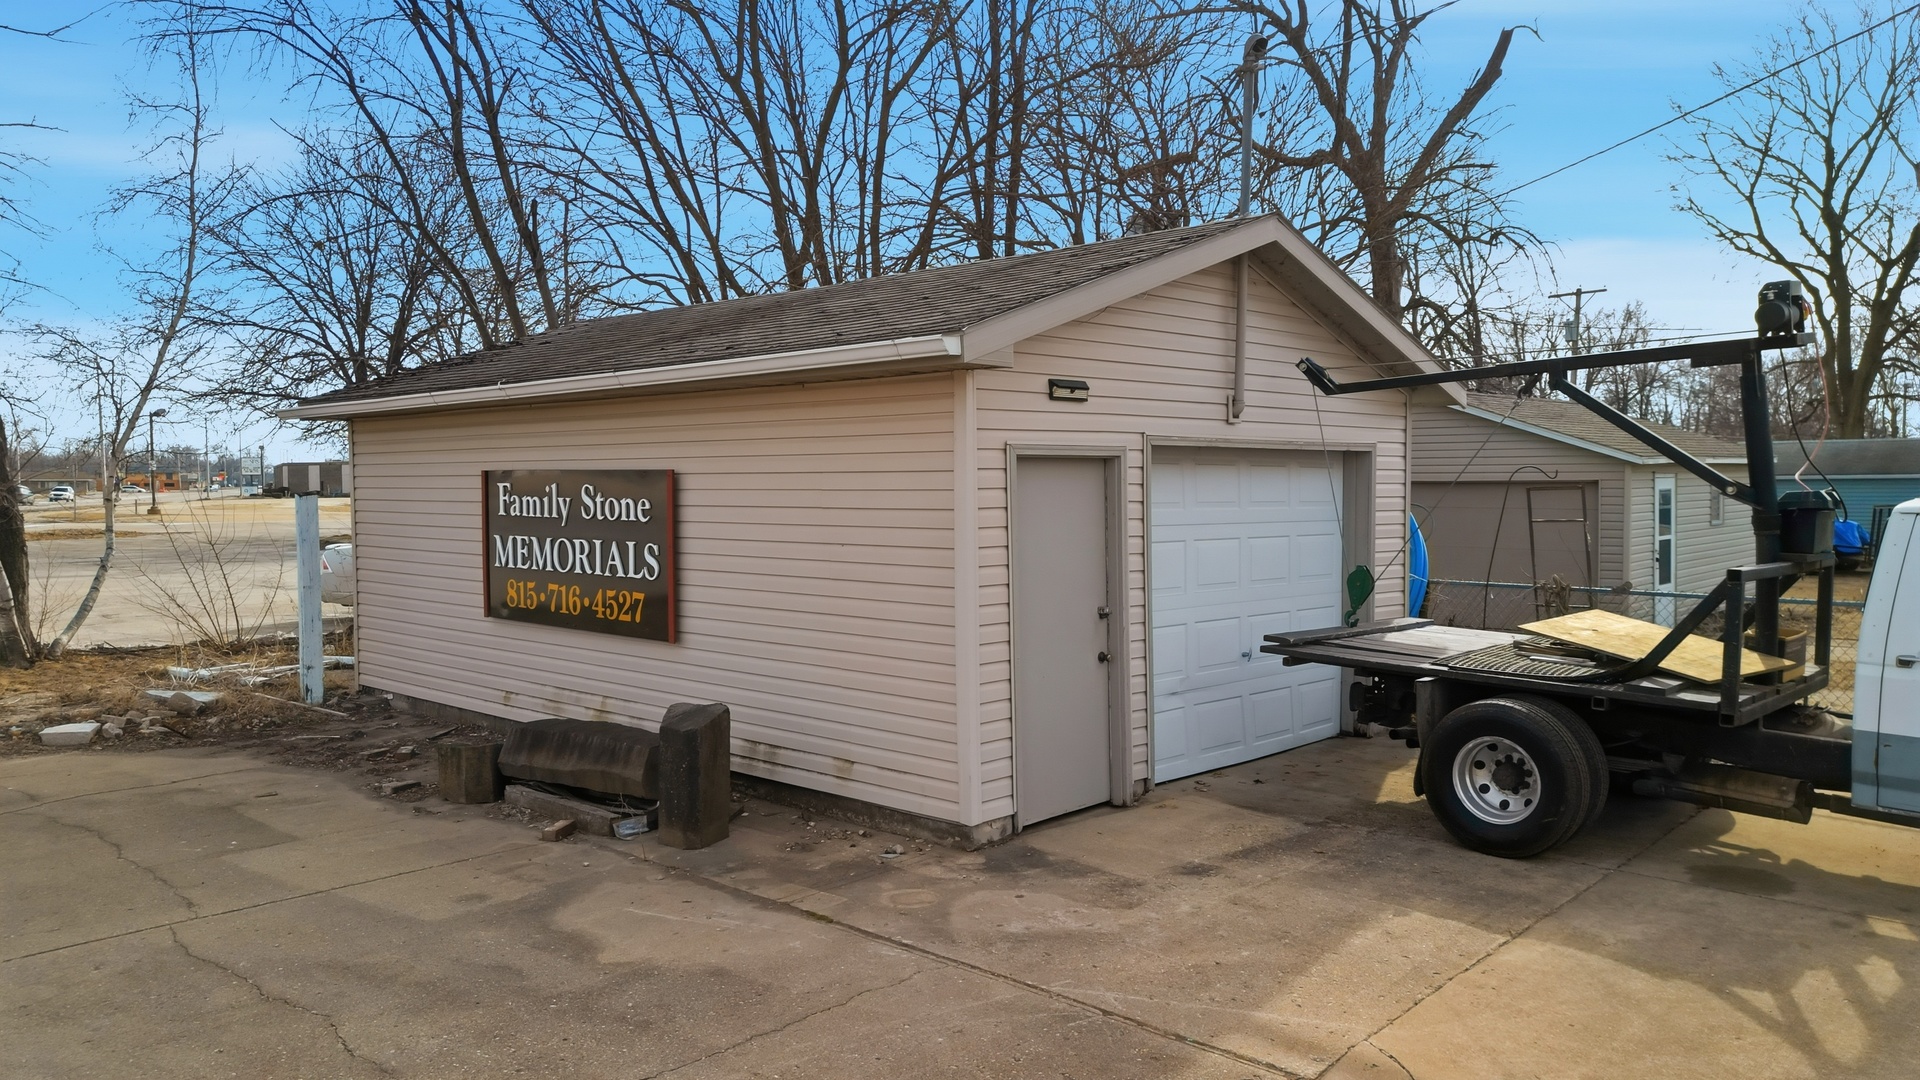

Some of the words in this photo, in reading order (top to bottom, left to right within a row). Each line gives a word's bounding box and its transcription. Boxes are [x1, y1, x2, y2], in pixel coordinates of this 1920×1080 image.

[497, 482, 572, 526] Family
[580, 483, 652, 523] Stone
[493, 534, 660, 581] MEMORIALS
